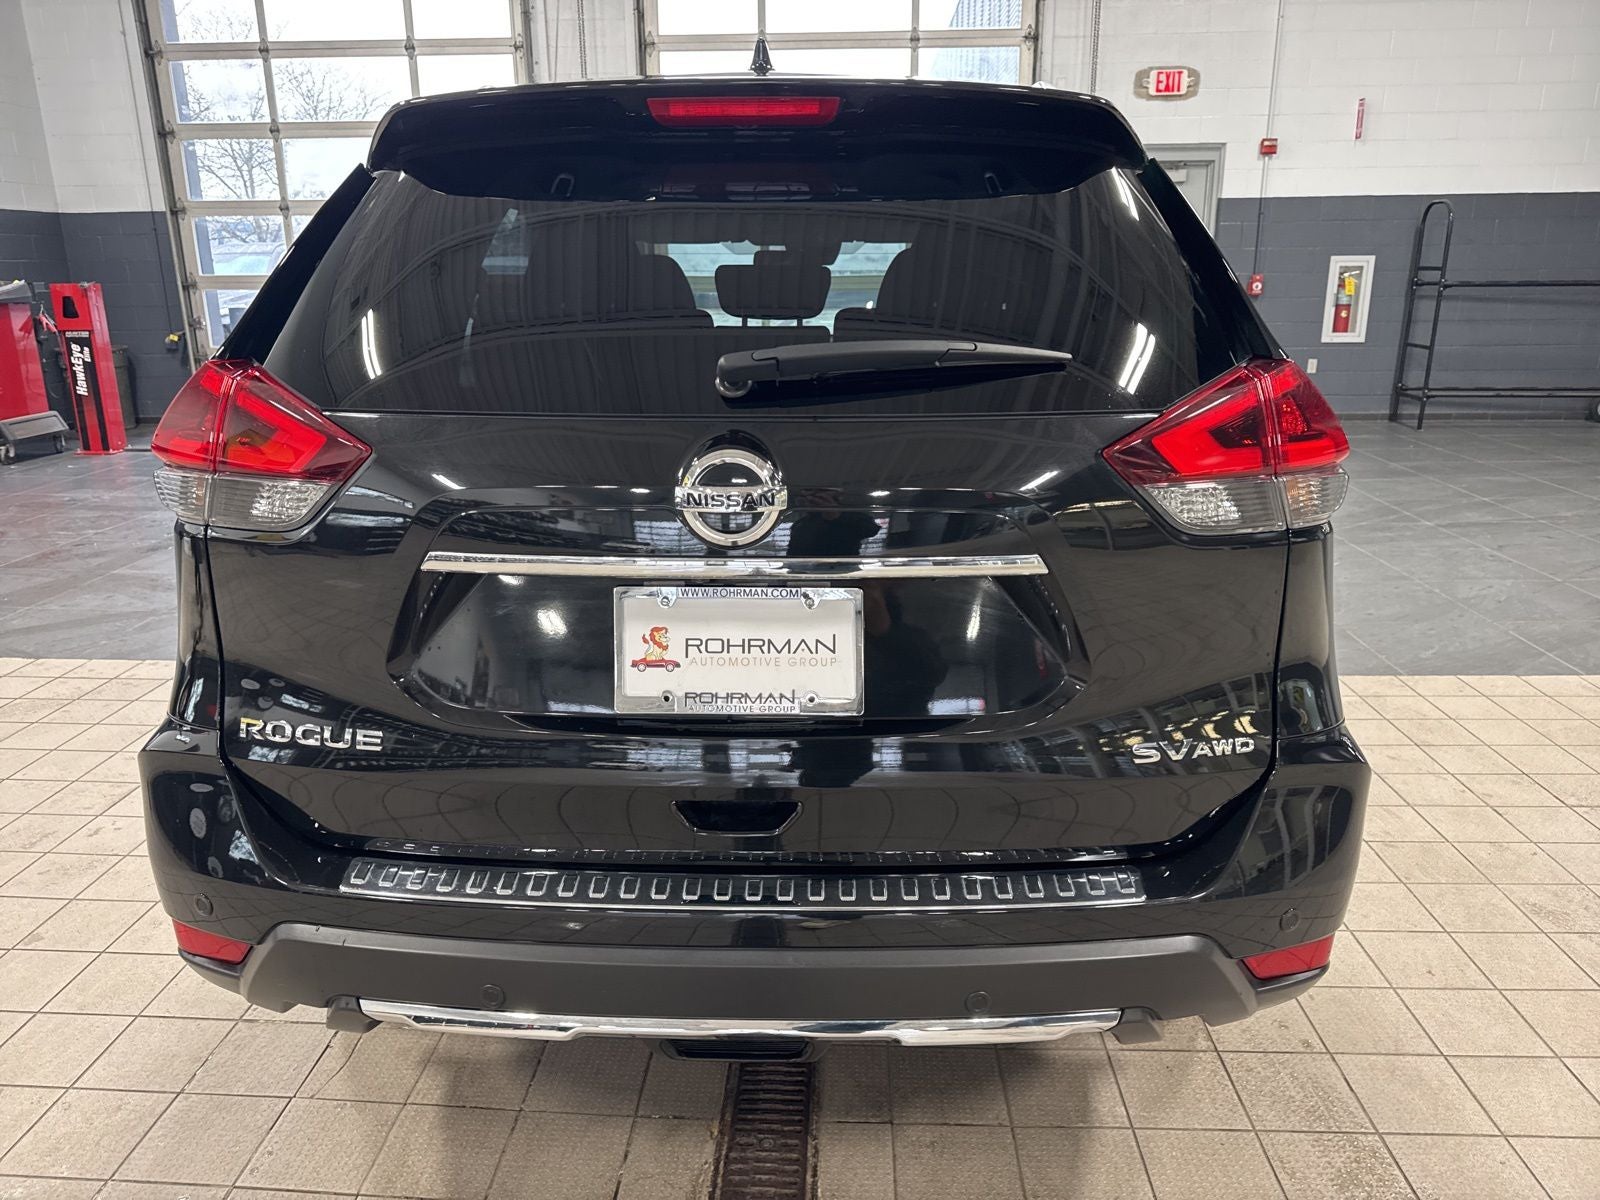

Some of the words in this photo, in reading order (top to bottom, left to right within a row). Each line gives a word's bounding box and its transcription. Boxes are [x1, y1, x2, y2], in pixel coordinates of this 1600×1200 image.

[1156, 71, 1184, 93] EXIT
[70, 343, 89, 396] HawkEye
[686, 492, 776, 508] NISSAN
[680, 588, 799, 598] WWW.ROHRMAN.COM
[685, 633, 837, 659] ROHRMAN
[690, 657, 781, 667] AUTOMOTIVE
[788, 657, 837, 667] GROUP
[684, 689, 796, 707] ROHRMAN
[688, 704, 758, 714] AUTOMOTIVE
[758, 704, 797, 714] GROUP
[239, 716, 384, 752] ROGUE
